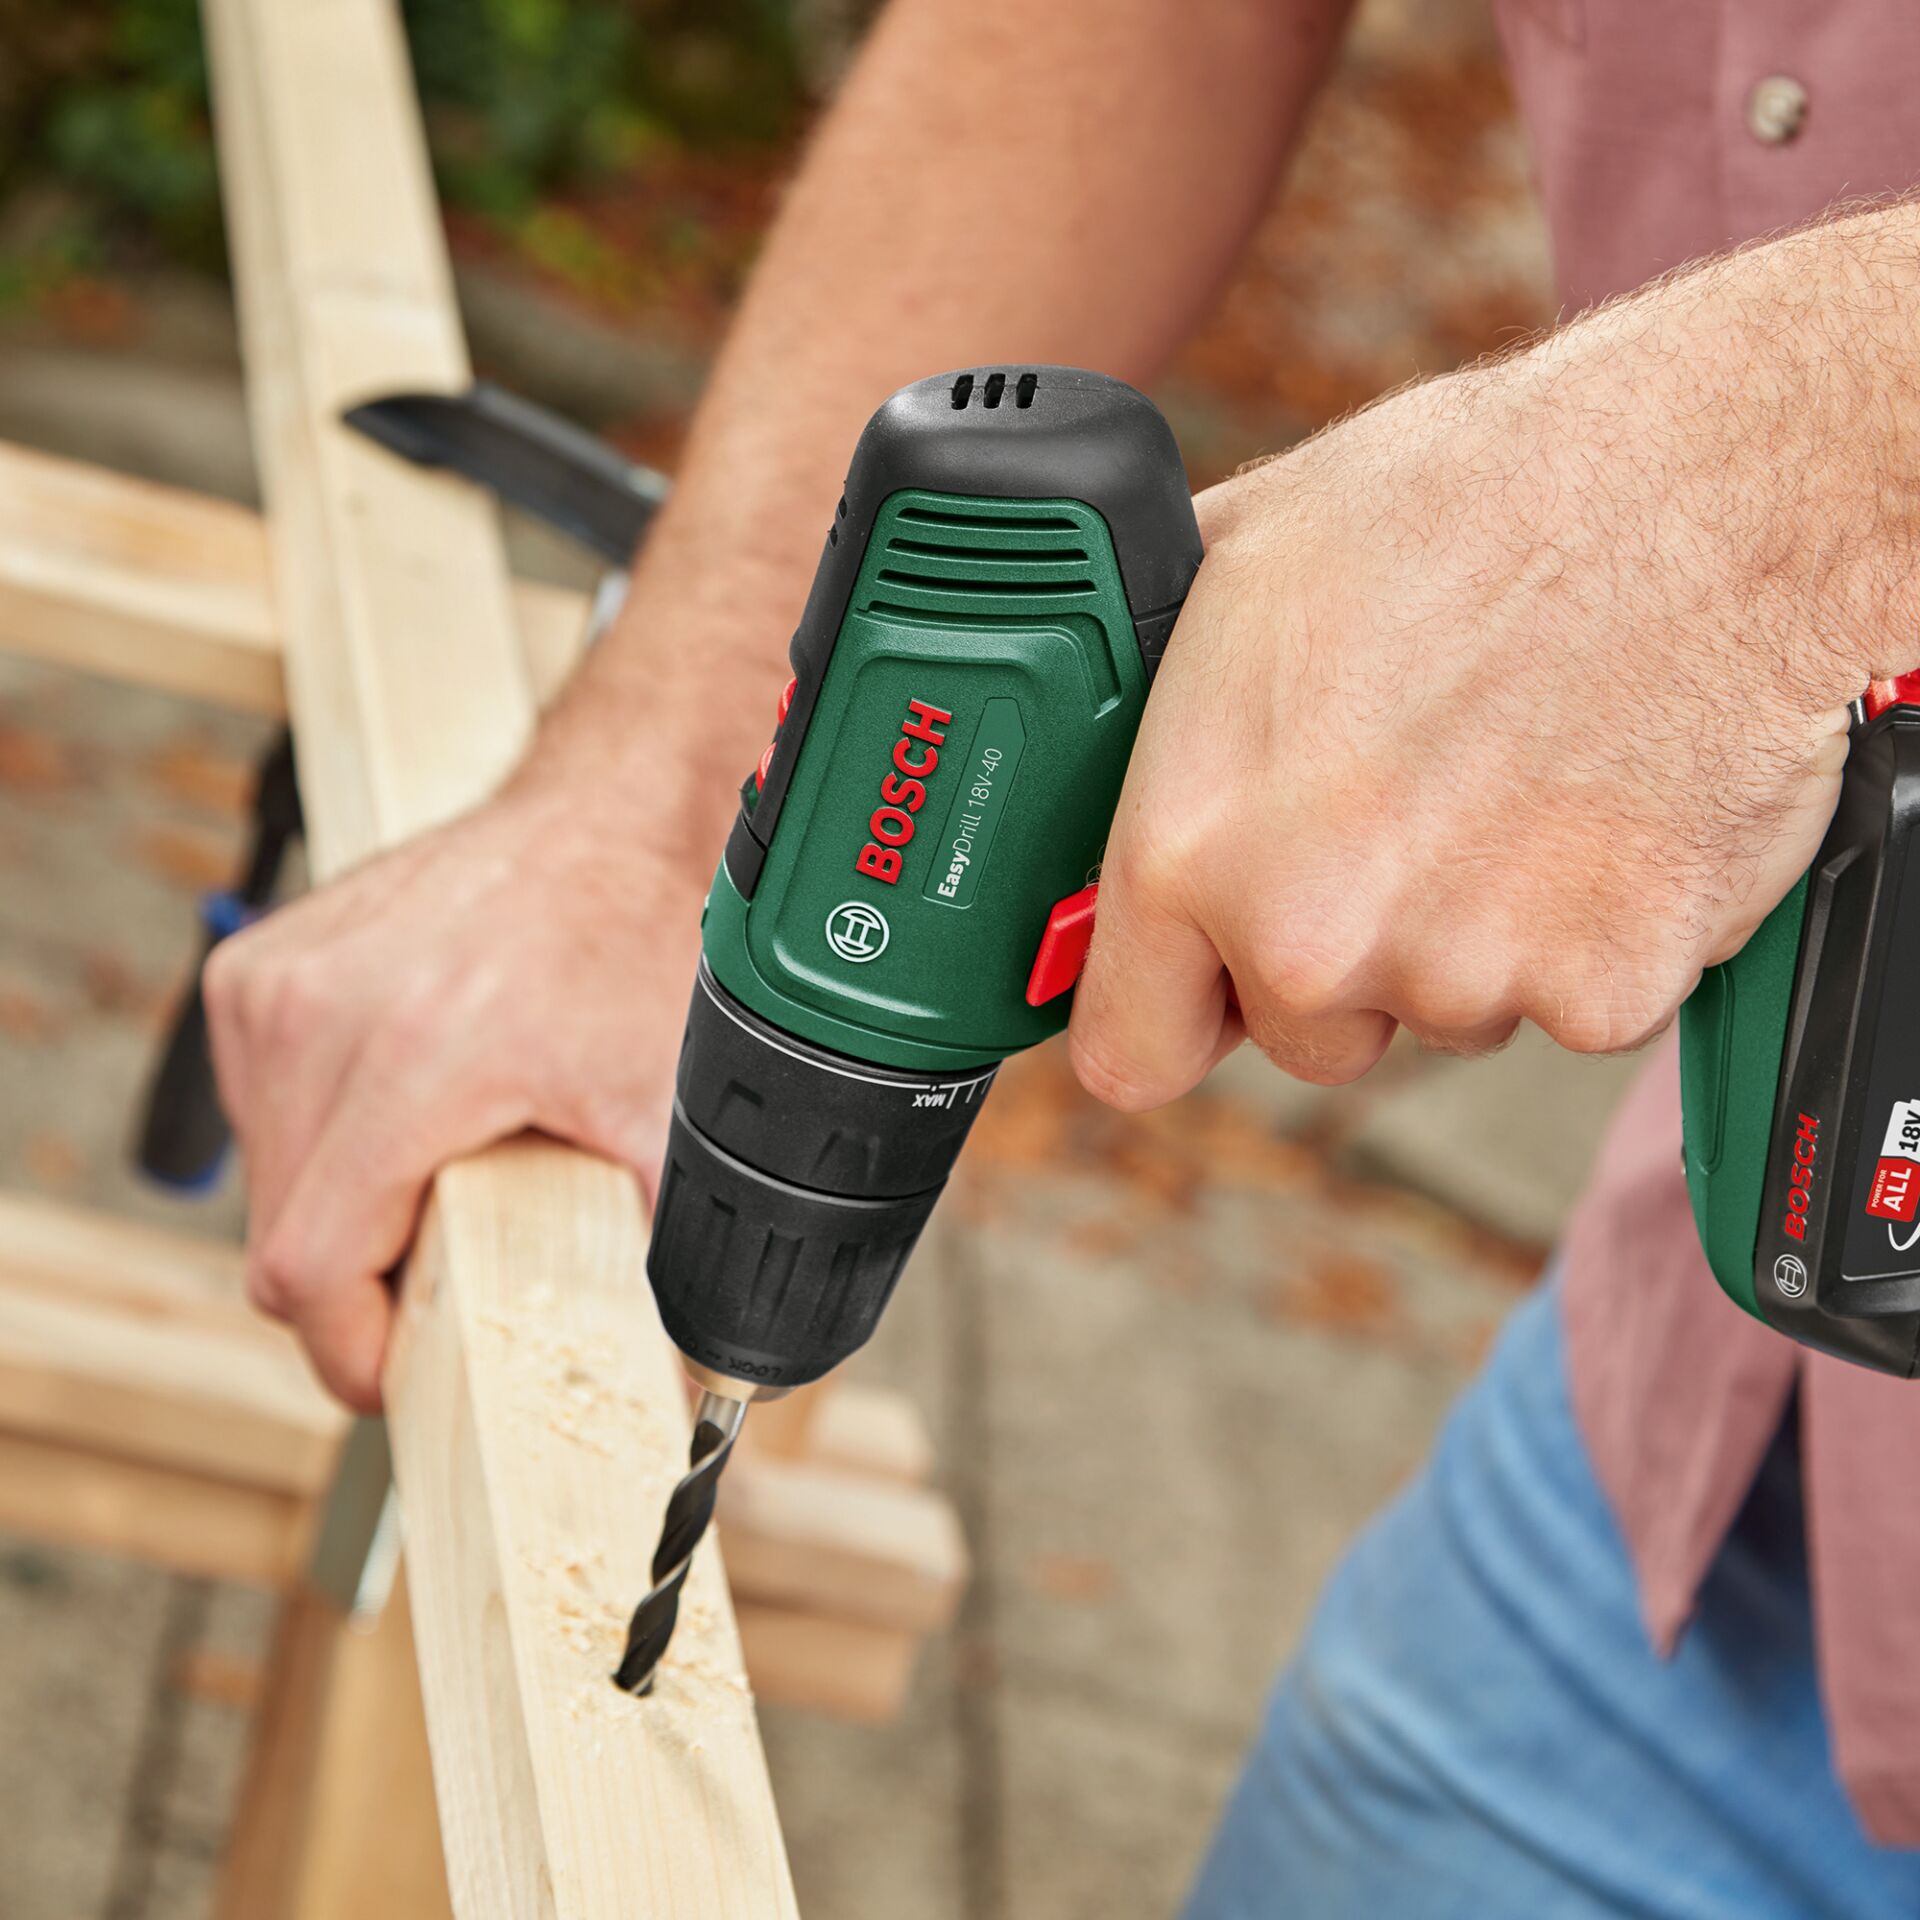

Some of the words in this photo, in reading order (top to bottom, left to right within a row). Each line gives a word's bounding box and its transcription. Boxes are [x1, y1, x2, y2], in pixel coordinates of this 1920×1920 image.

[855, 699, 952, 885] BOSCH
[937, 813, 981, 897] EasyDrill
[968, 748, 1002, 808] 18V-40
[912, 1094, 947, 1108] MAX
[1898, 1109, 1920, 1153] 18V
[1784, 1113, 1820, 1240] BOSCH
[1871, 1184, 1883, 1208] POWER
[1877, 1169, 1887, 1184] FOR
[1883, 1167, 1912, 1212] ALL
[728, 1357, 782, 1379] LOCK
